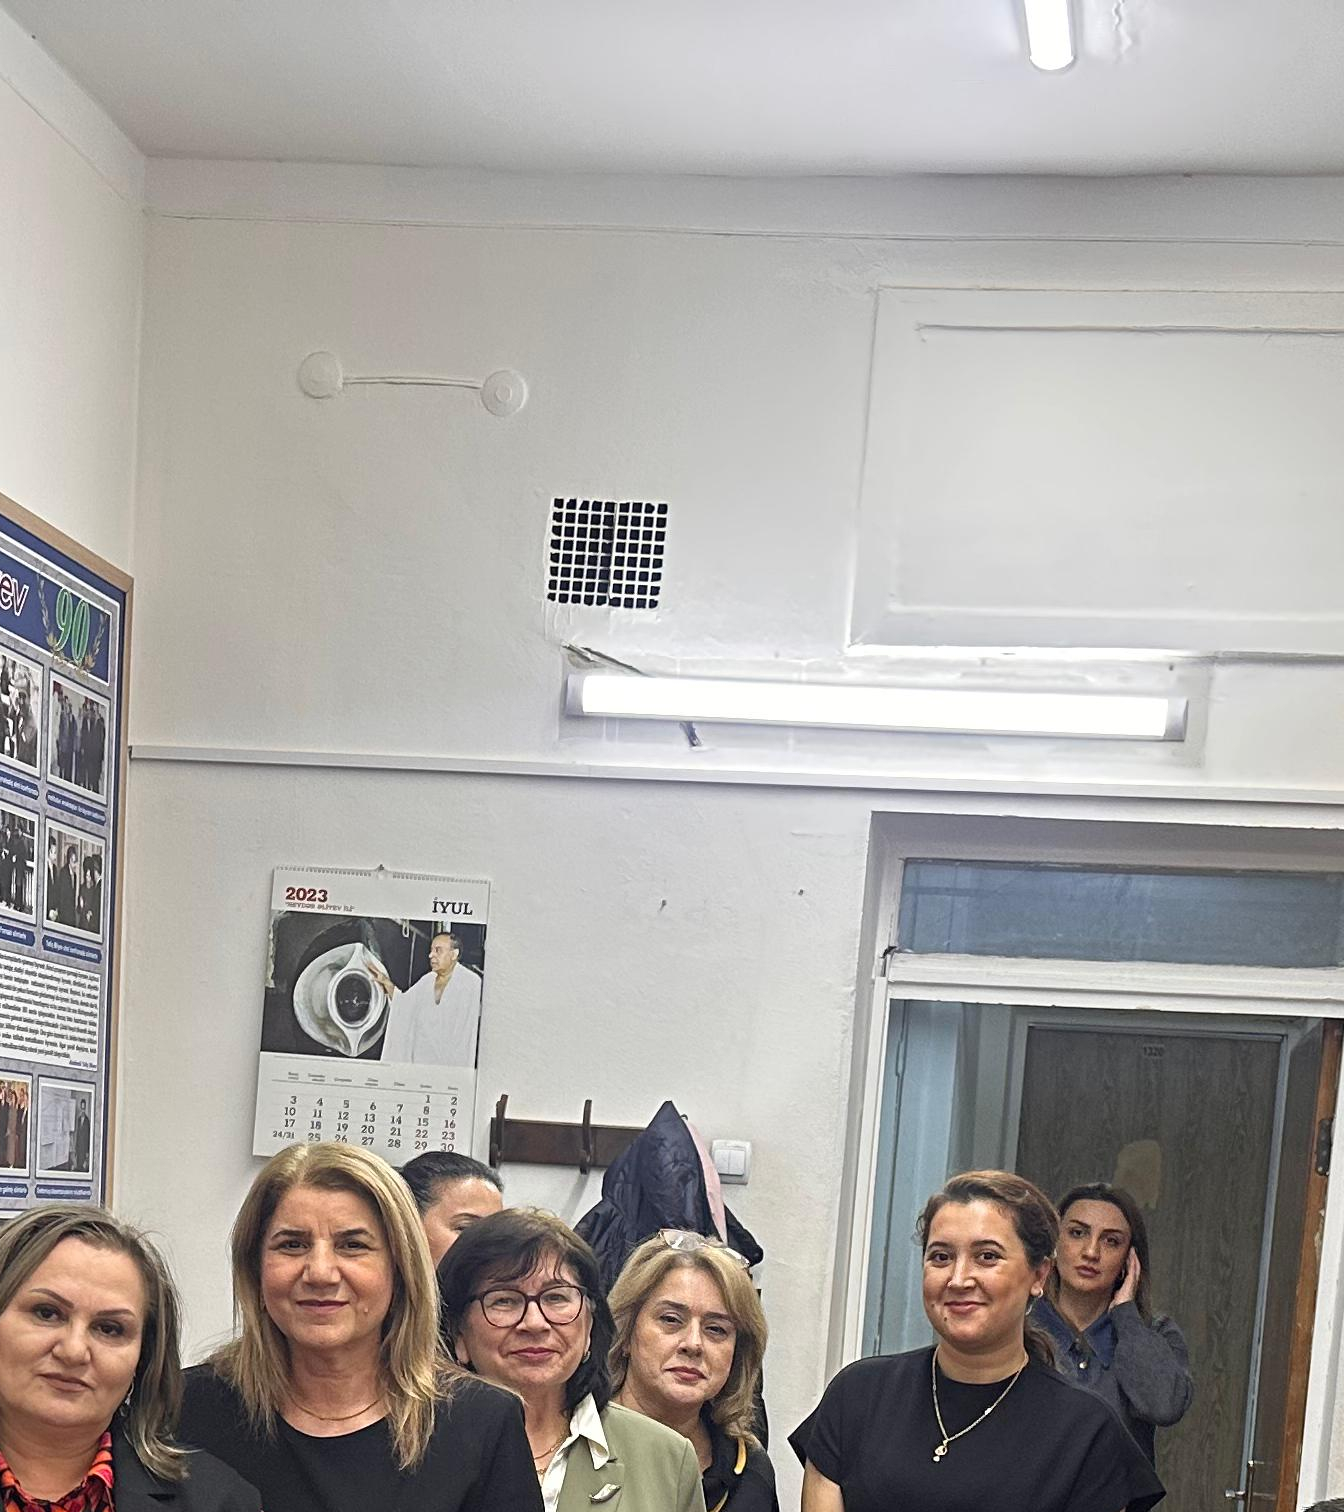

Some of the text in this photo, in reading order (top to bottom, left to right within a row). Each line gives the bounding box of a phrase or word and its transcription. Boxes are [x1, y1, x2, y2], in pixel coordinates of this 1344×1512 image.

[55, 586, 93, 665] 90
[285, 886, 328, 903] 2023
[432, 897, 473, 916] İYUL
[290, 1096, 456, 1117] 3 4 5 6 7 8 9
[426, 1095, 457, 1105] 1 2
[284, 1107, 456, 1128] 10 11 12 13 14 15 16
[284, 1119, 456, 1140] 17 18 19 20 21 22 23
[308, 1132, 321, 1142] 25
[335, 1134, 348, 1144] 26
[362, 1136, 375, 1146] 27
[388, 1138, 401, 1148] 28
[414, 1141, 428, 1150] 29
[441, 1142, 454, 1153] 30
